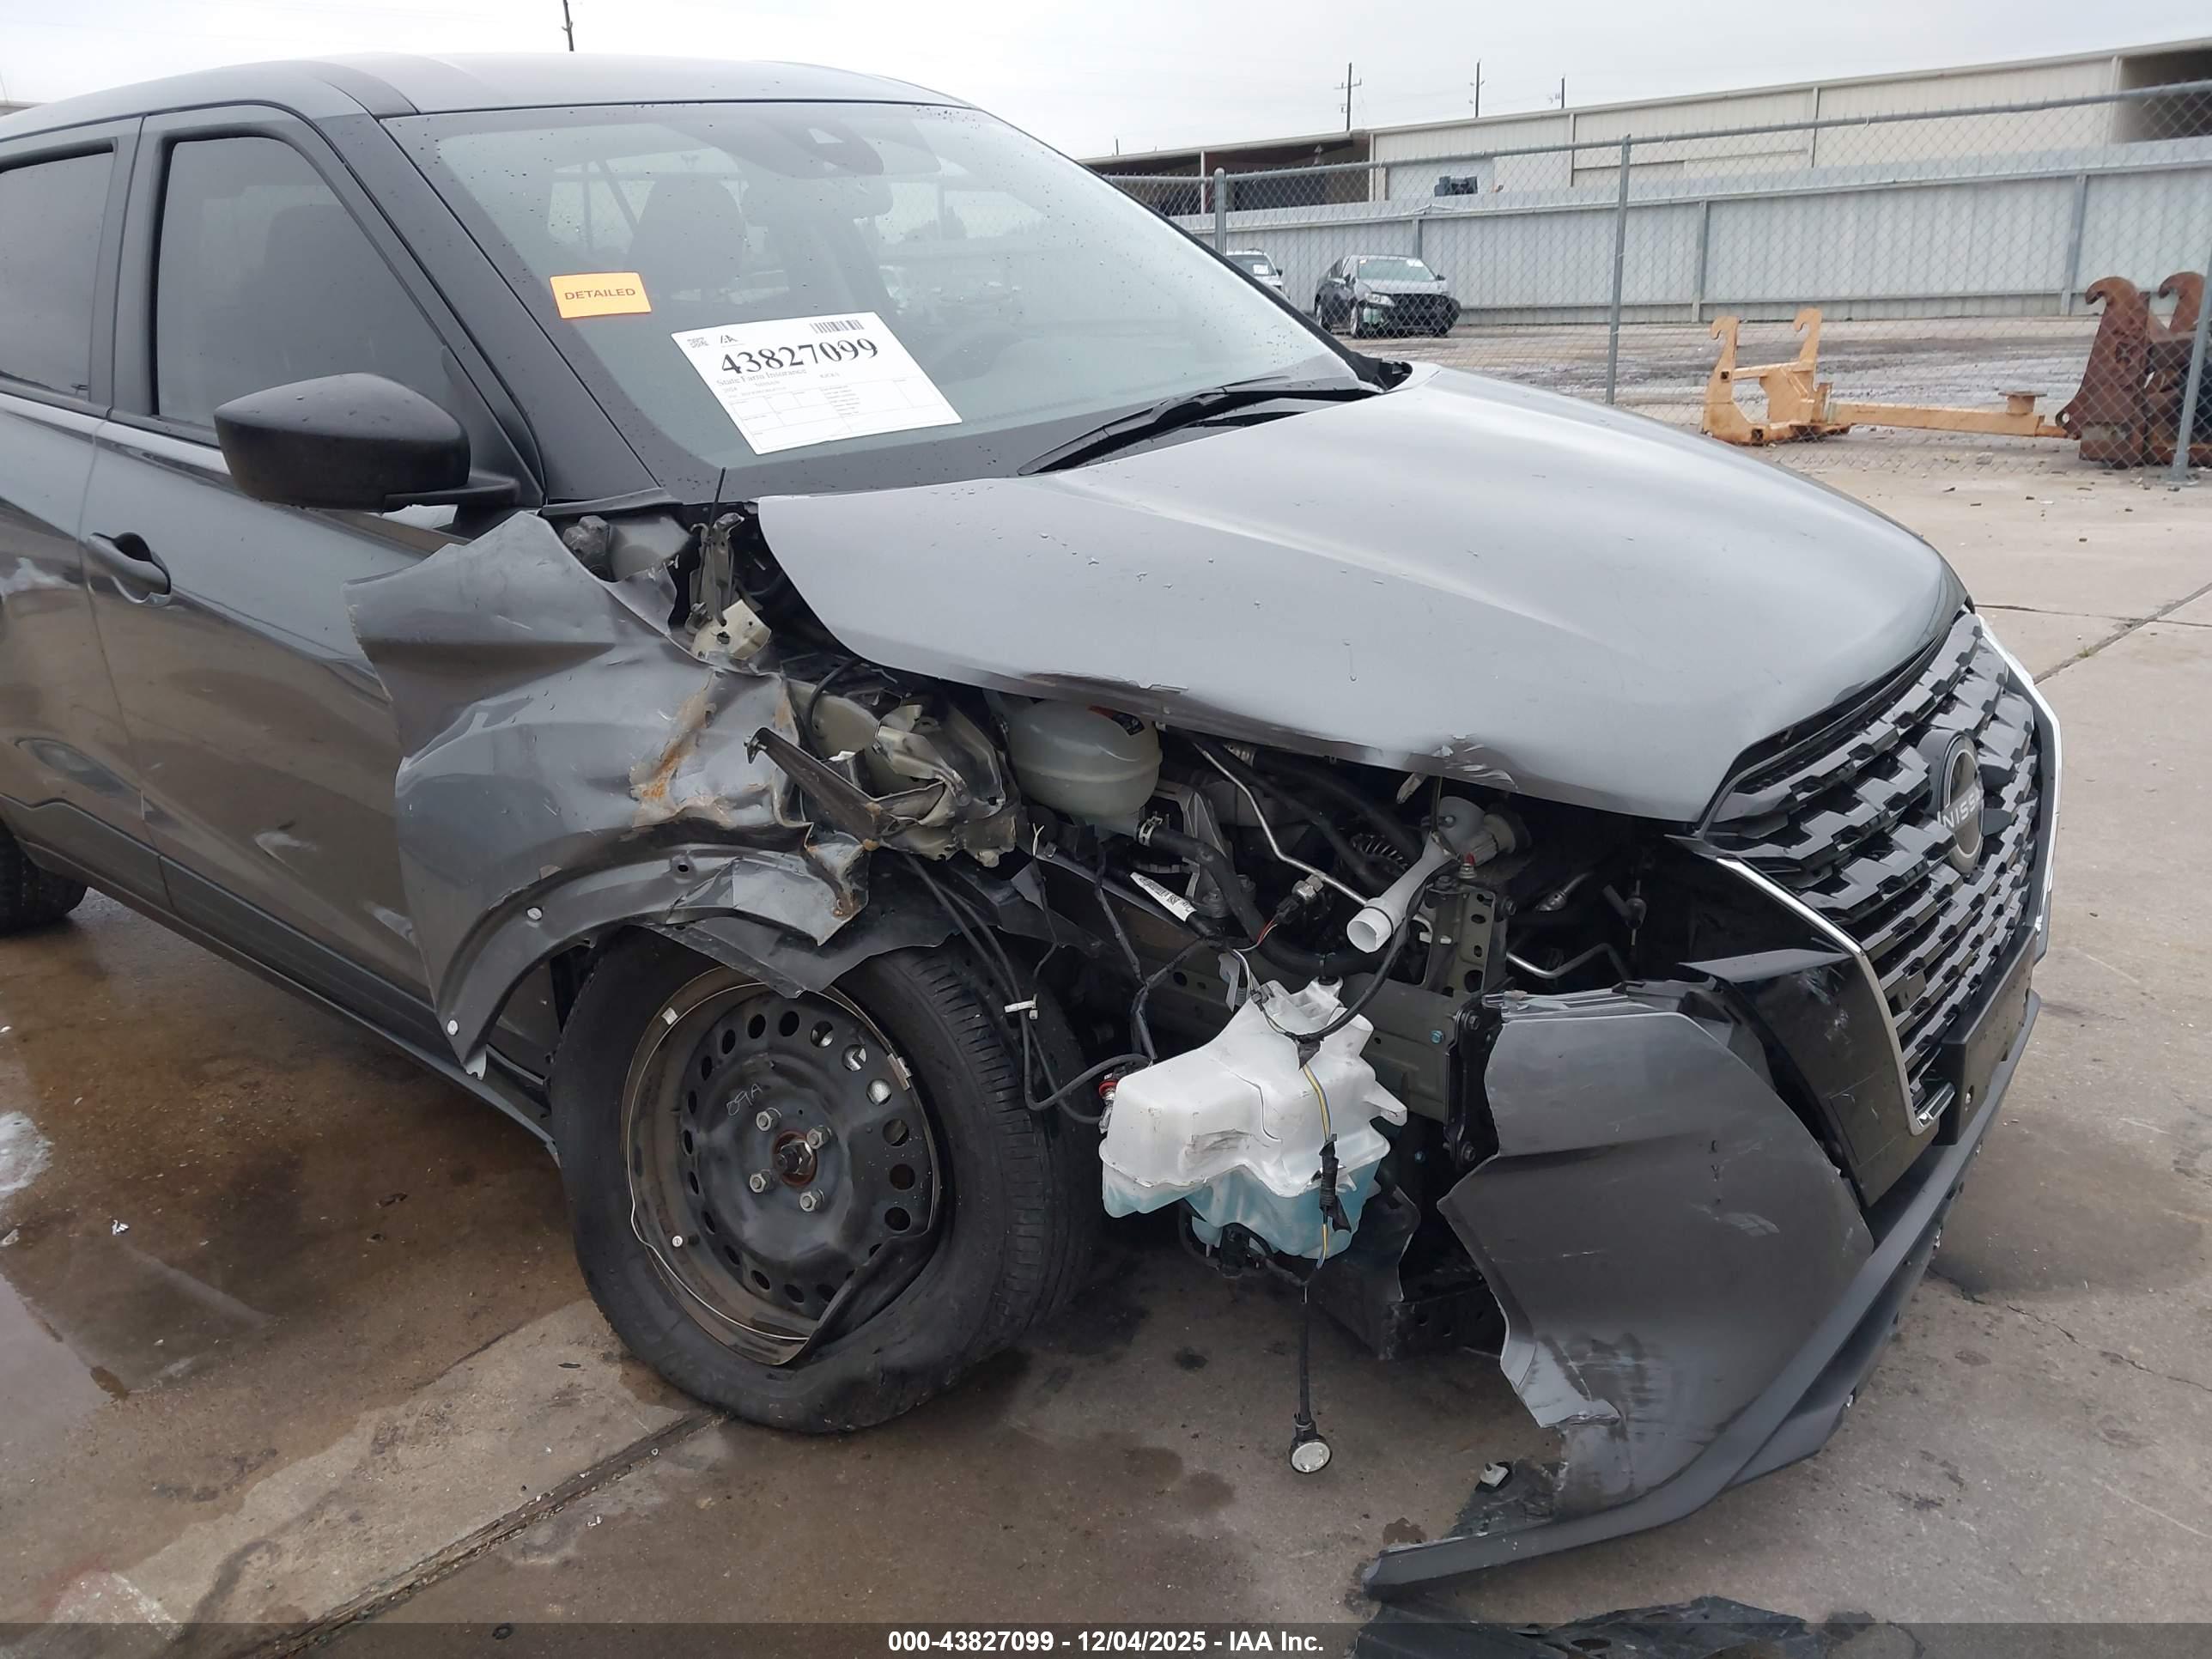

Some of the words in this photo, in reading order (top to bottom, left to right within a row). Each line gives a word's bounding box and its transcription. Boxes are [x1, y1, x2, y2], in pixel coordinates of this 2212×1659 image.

[564, 288, 635, 300] DETAILED
[720, 337, 878, 374] 43827099
[716, 378, 741, 386] State
[741, 374, 764, 383] Farm
[765, 368, 807, 380] Insurance
[1942, 787, 1982, 829] NISS
